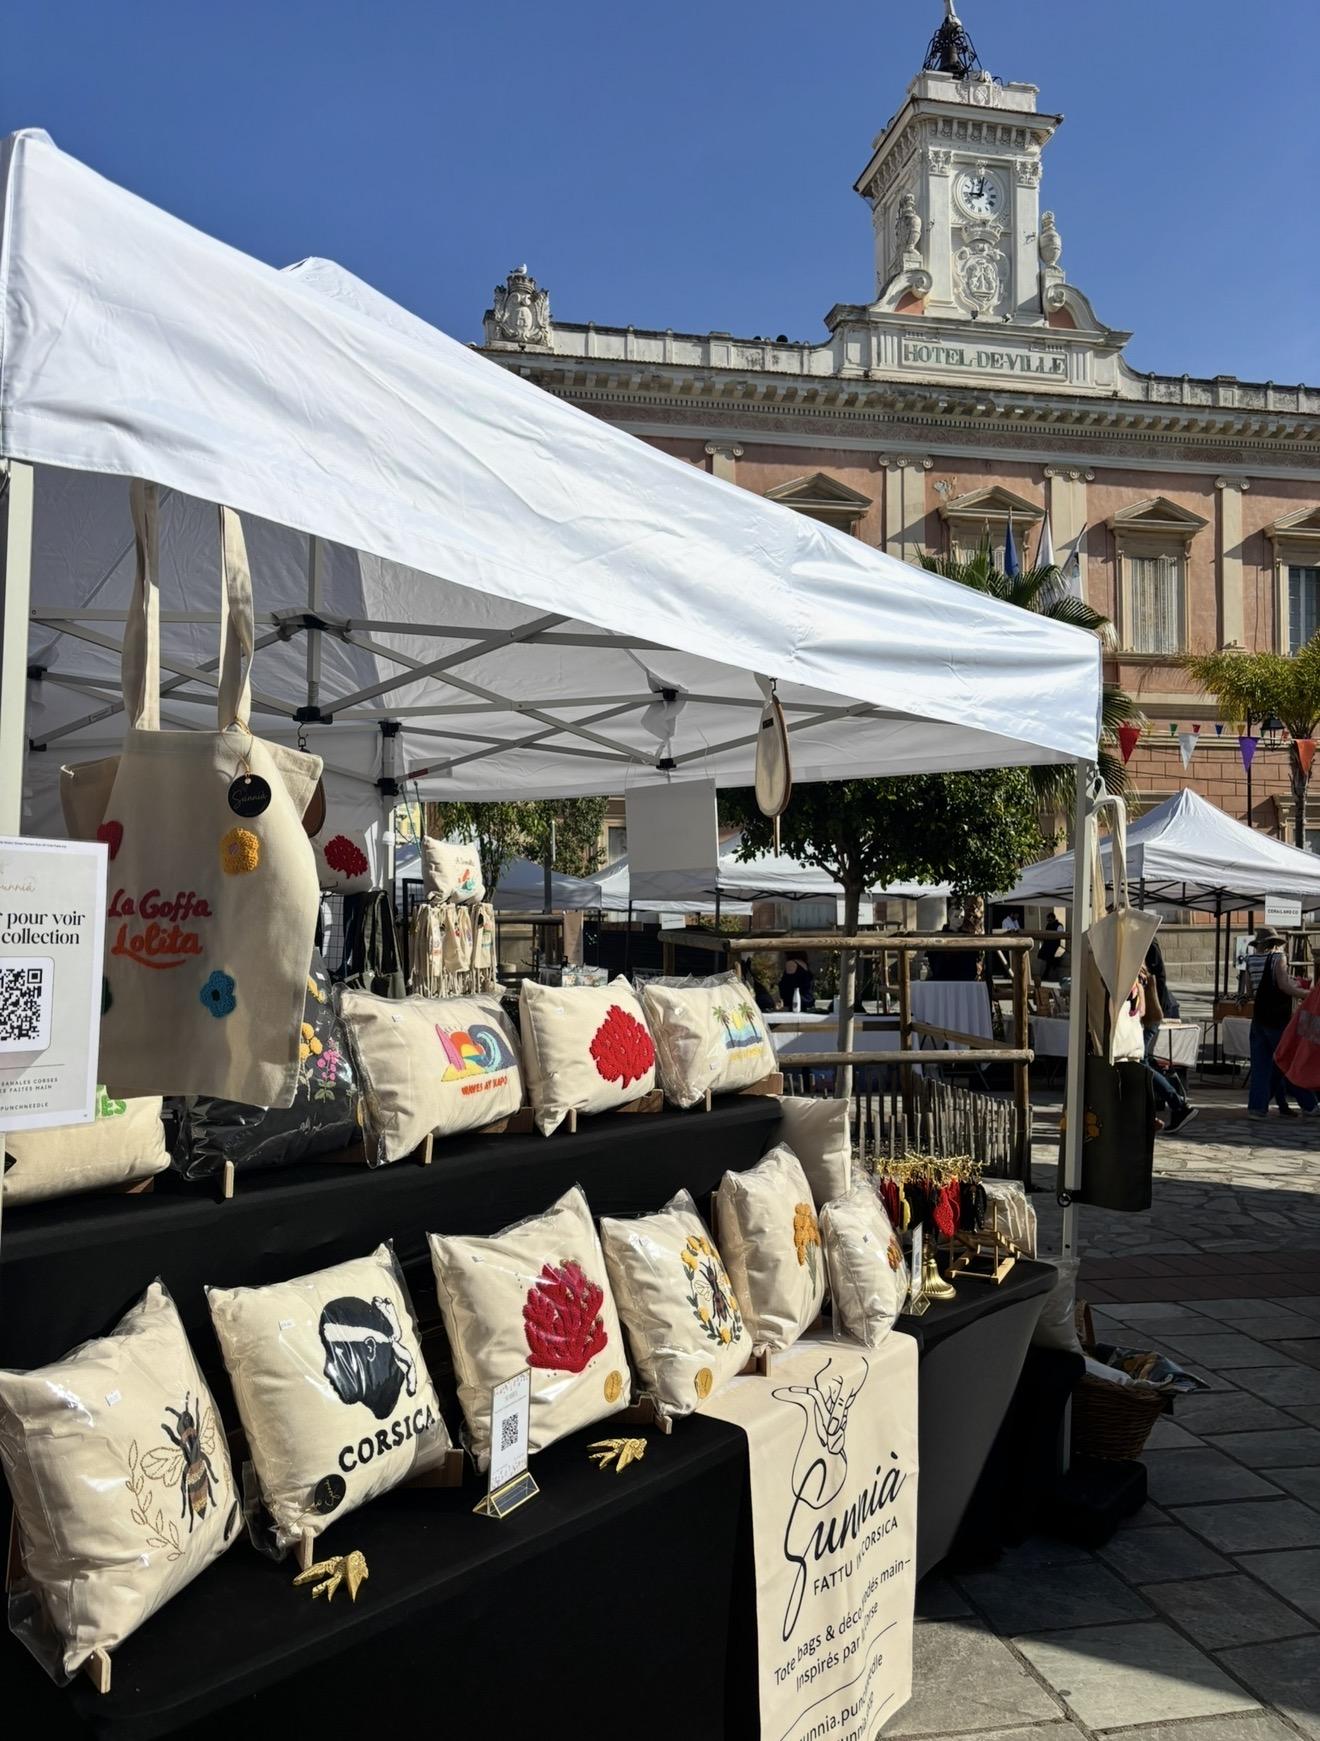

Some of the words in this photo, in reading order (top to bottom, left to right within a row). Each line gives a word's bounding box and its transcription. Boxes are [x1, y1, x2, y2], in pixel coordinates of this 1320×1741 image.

[7, 912, 48, 930] pour
[52, 910, 86, 926] voir
[108, 888, 135, 918] La
[139, 888, 213, 922] Goffa
[1, 927, 80, 945] collection
[111, 922, 204, 956] Lolita
[96, 1094, 127, 1117] ES
[338, 1404, 436, 1473] CORSICA
[813, 1559, 854, 1597] FATTU
[861, 1515, 899, 1557] CORSICA
[774, 1657, 797, 1686] Tote
[796, 1634, 822, 1663] bags
[825, 1614, 836, 1642] &
[796, 1650, 840, 1693] Inspirés
[842, 1636, 861, 1664] par
